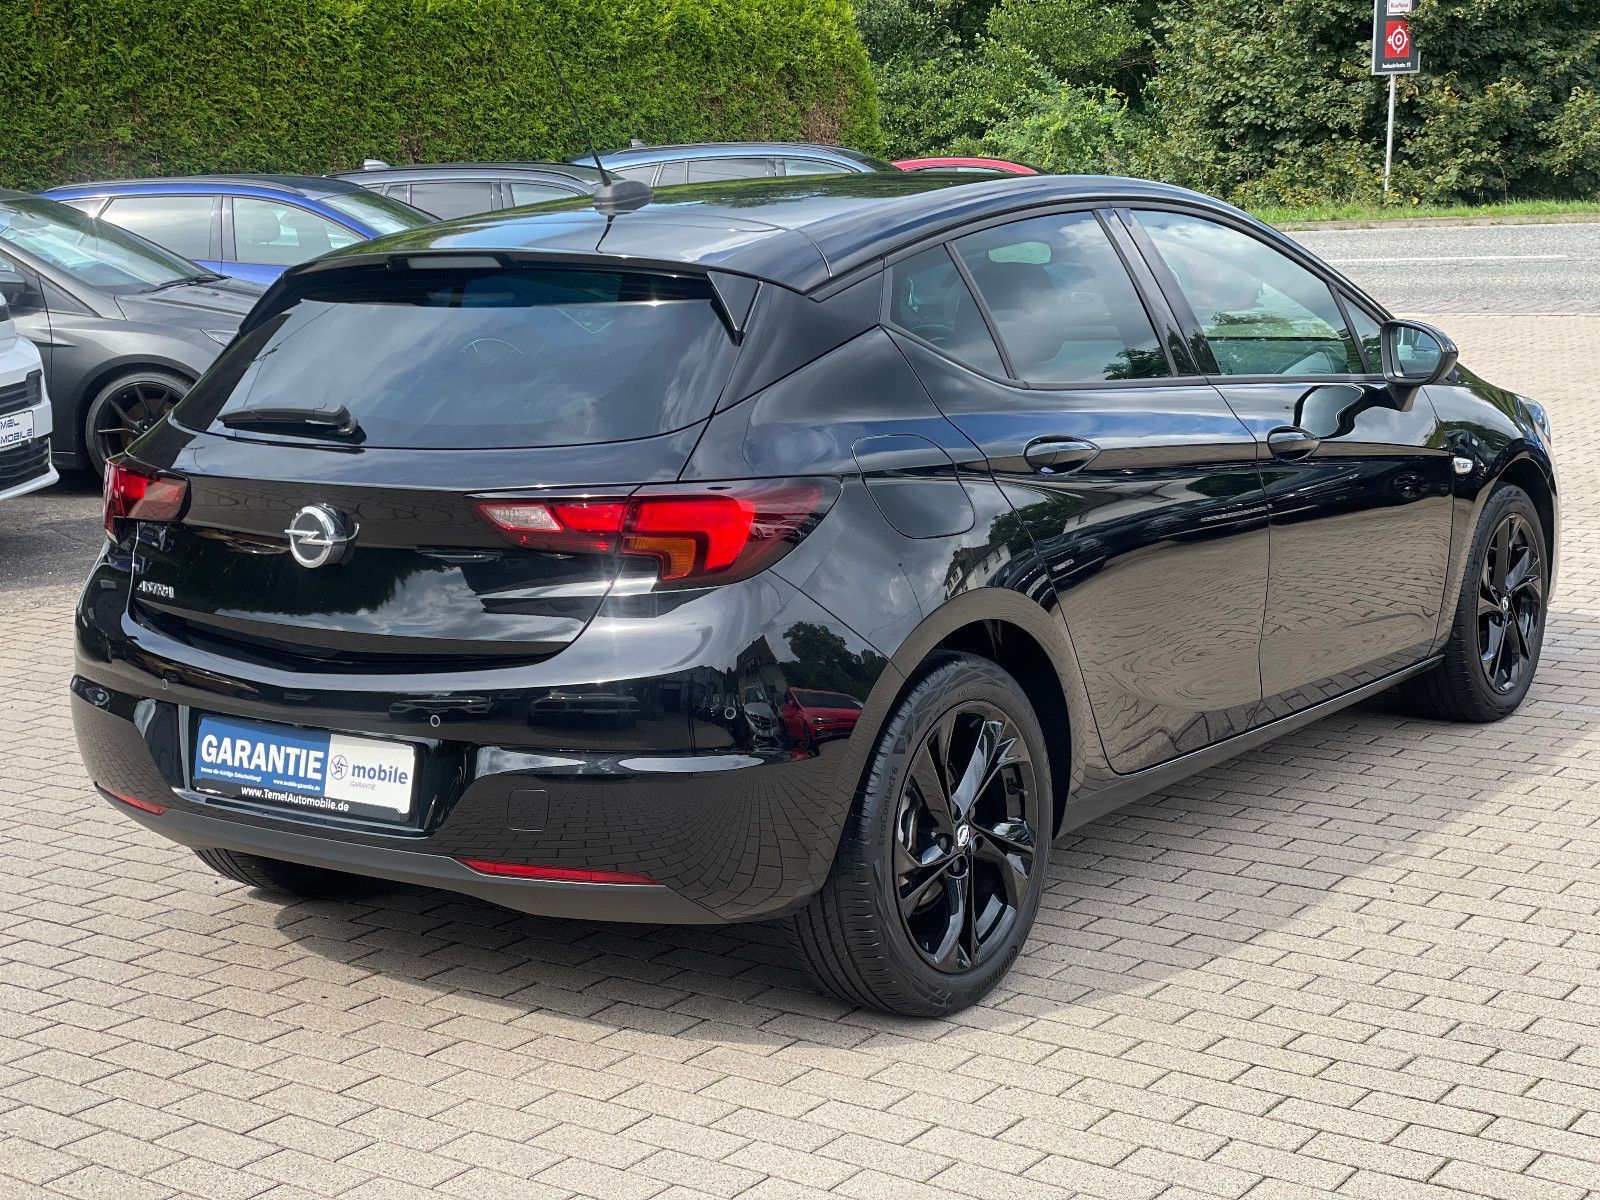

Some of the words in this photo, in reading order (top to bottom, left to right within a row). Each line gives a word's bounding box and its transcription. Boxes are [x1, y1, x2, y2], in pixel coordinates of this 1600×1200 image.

[201, 734, 325, 781] GARANTIE
[349, 780, 376, 791] GARANTIE
[351, 763, 409, 785] mobile
[241, 786, 349, 812] www.TemelAutomobile.de
